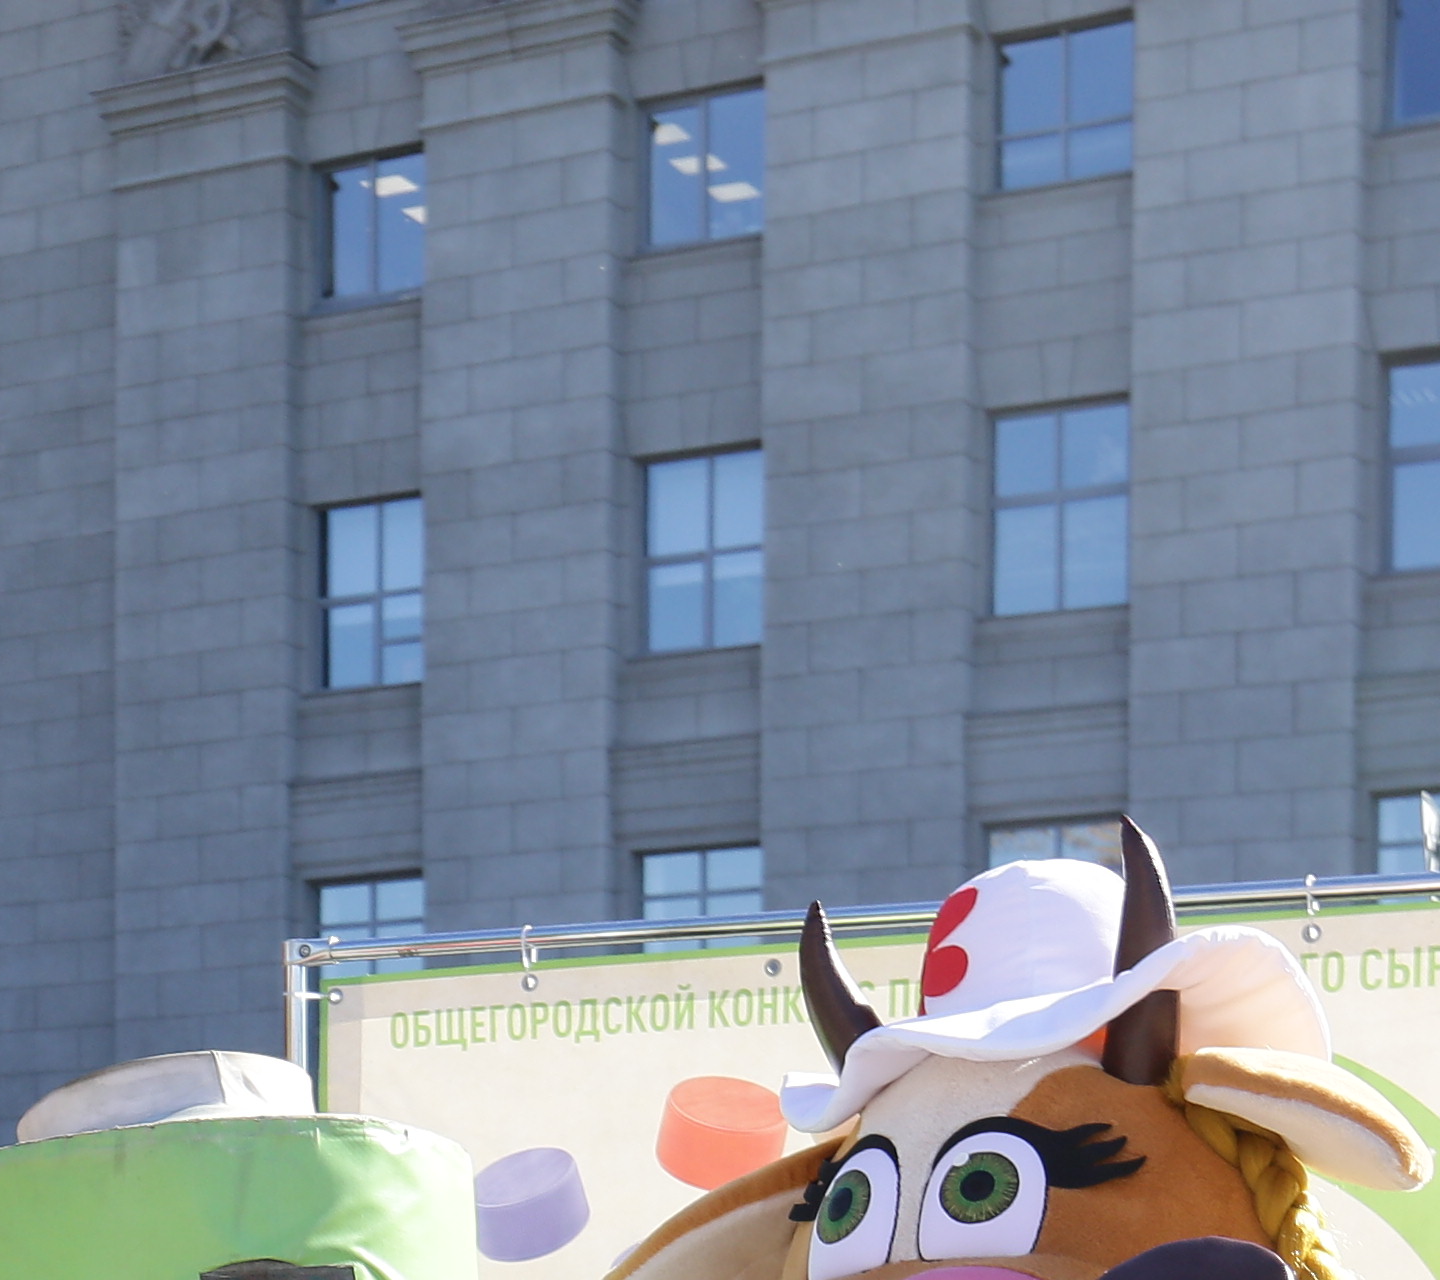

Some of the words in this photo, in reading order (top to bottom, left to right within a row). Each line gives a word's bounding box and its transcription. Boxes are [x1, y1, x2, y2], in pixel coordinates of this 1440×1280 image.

[389, 983, 697, 1052] ОБЩЕГОРОДСКОЙ
[707, 979, 876, 1029] КОНК
[1300, 950, 1346, 993] ГО
